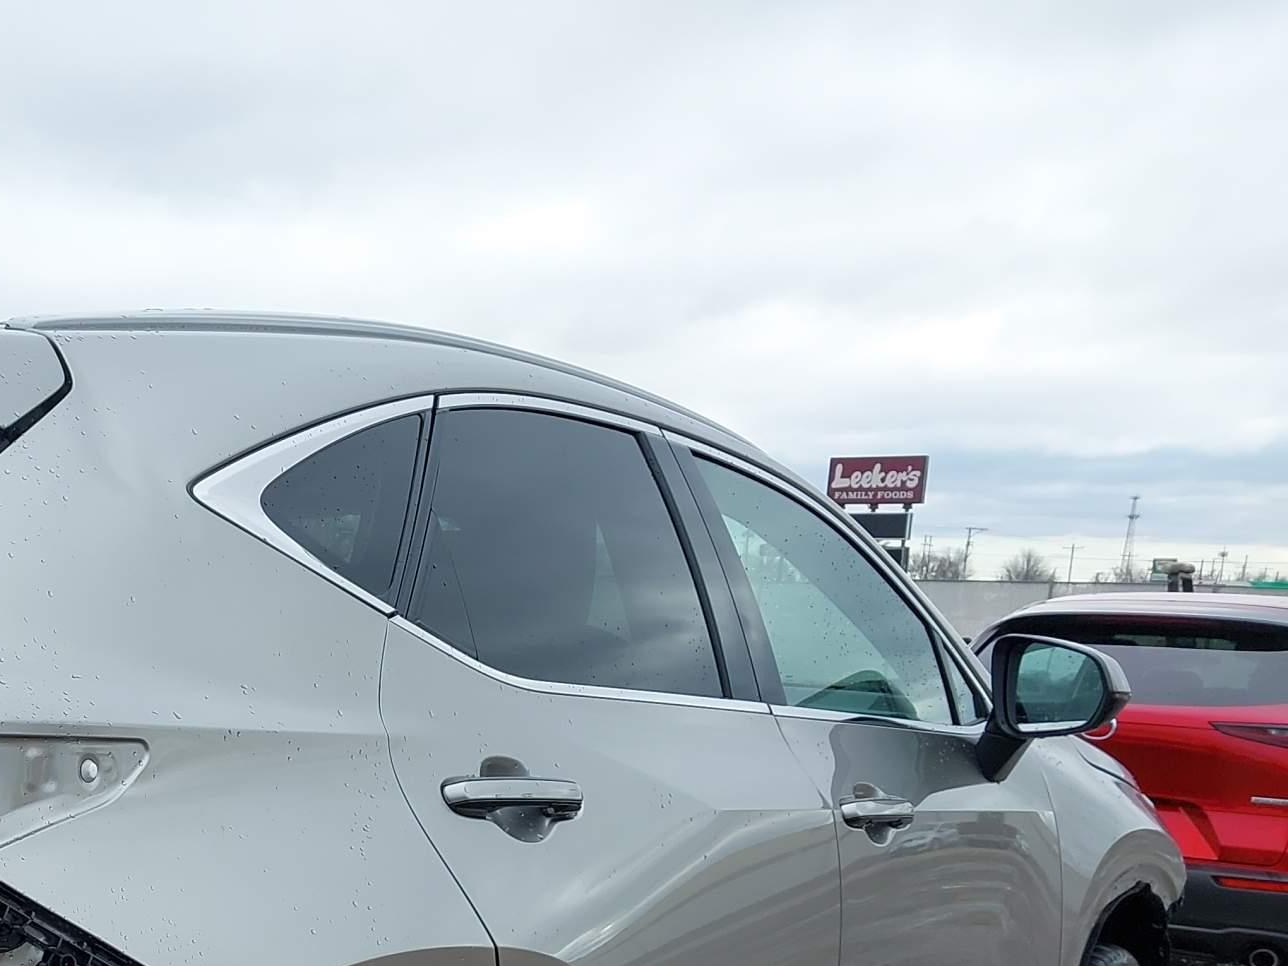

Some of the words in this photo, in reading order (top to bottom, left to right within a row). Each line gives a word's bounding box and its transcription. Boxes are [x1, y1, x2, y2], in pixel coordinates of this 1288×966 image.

[831, 462, 921, 488] Leeker's
[834, 491, 874, 499] FAMILY
[877, 490, 914, 499] FOODS
